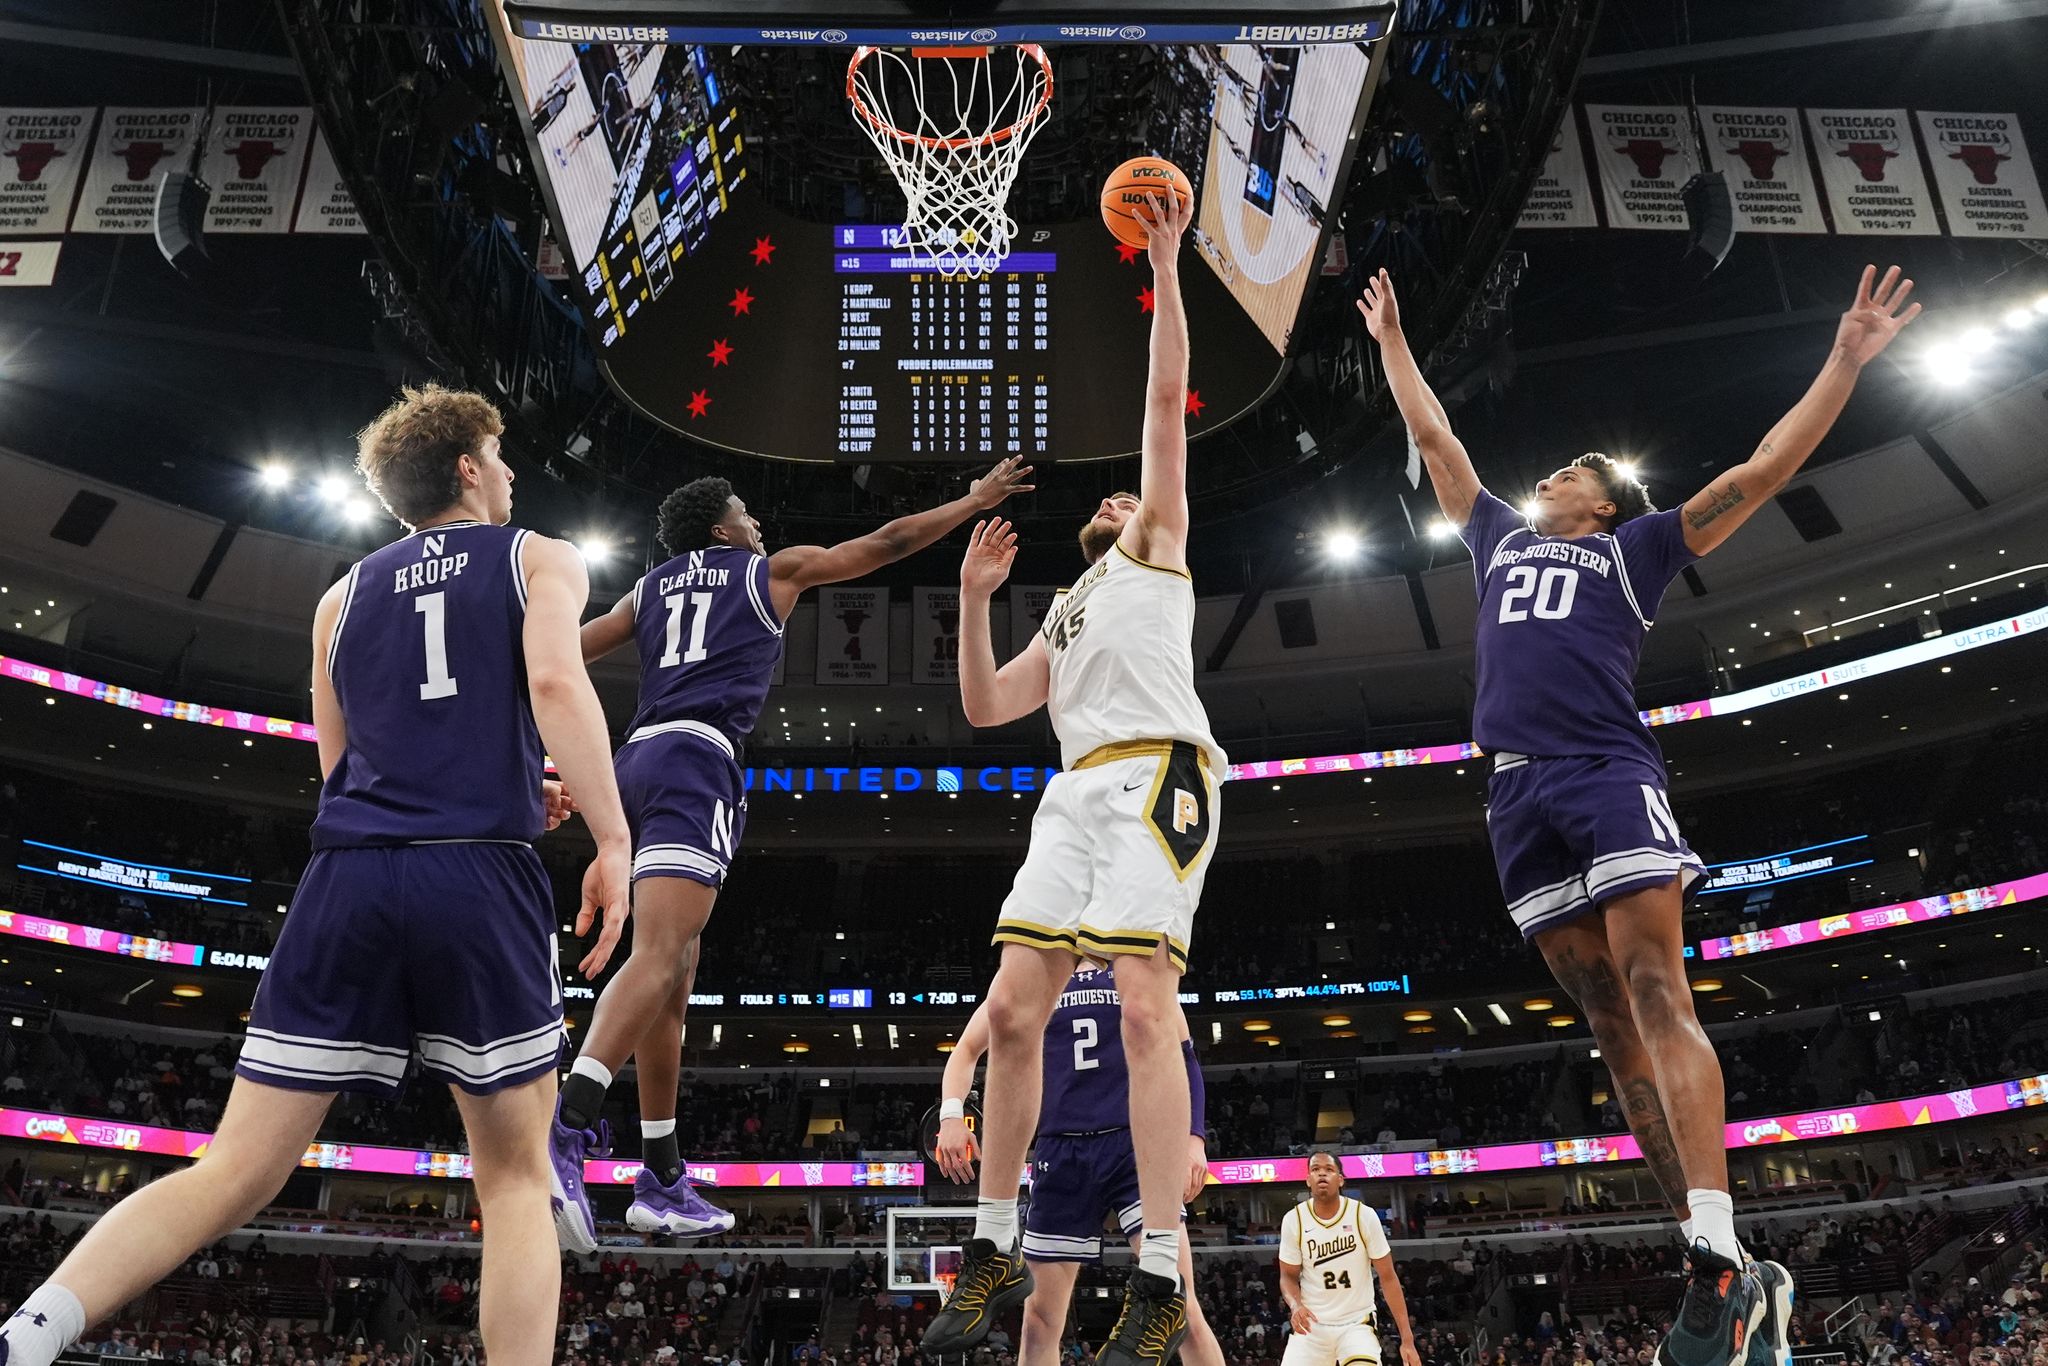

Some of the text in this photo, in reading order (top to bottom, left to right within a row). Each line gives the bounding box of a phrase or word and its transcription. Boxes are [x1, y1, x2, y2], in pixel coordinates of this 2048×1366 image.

[537, 24, 669, 42] #B1GMBBT
[762, 30, 820, 40] Allstate
[911, 31, 970, 40] Allstate
[1060, 26, 1120, 38] Allstate
[1235, 22, 1369, 41] #B1GMBBT
[8, 115, 81, 127] CHICAGO
[116, 114, 190, 126] CHICAGO
[226, 114, 299, 125] CHICAGO
[1602, 112, 1677, 125] CHICAGO
[1712, 112, 1787, 126] CHICAGO
[1820, 116, 1896, 128] CHICAGO
[1932, 118, 2008, 130] CHICAGO
[16, 128, 70, 140] BULLS
[123, 128, 180, 139] BULLS
[234, 128, 287, 138] BULLS
[1616, 126, 1669, 137] BULLS
[1728, 128, 1780, 138] BULLS
[1836, 129, 1889, 140] BULLS
[1948, 132, 2001, 143] BULLS
[1132, 168, 1176, 182] NCAA
[4, 182, 48, 192] CENTRAL
[111, 184, 156, 193] CENTRAL
[224, 183, 268, 191] CENTRAL
[1631, 180, 1675, 188] EASTERN
[1744, 180, 1787, 190] EASTERN
[1854, 185, 1900, 194] EASTERN
[1624, 190, 1681, 200] CONFERENC
[1736, 192, 1801, 202] CONFERENCE
[1968, 187, 2012, 197] EASTERN
[106, 196, 154, 205] DIVISION
[220, 194, 268, 203] DIVISION
[1848, 197, 1914, 206] CONFERENCE
[1961, 198, 2027, 209] CONFERENCE
[95, 208, 154, 216] CHAMPION
[209, 206, 273, 215] CHAMPIONS
[1738, 204, 1803, 214] CHAMPIONS
[1852, 208, 1916, 218] CHAMPIONS
[1751, 216, 1796, 225] 1995-96
[1964, 210, 2030, 220] CHAMPIONS
[99, 220, 149, 228] 1996-97
[1861, 220, 1912, 229] 1996-97
[844, 229, 854, 244] N
[0, 252, 22, 276] 2
[842, 258, 860, 268] #15
[850, 284, 873, 295] KROPP
[913, 284, 919, 295] 6
[850, 298, 891, 309] MARTINELLI
[912, 298, 921, 309] 13
[850, 312, 870, 322] WEST
[912, 312, 921, 322] 12
[841, 326, 919, 336] 11 CLAYTON 3
[838, 340, 919, 350] 20 MULLINS 4
[842, 359, 994, 370] #7 PURDUE BOILERMAKERS
[850, 386, 872, 396] SMITH
[912, 386, 921, 396] 11
[840, 400, 919, 410] 14 BENTER 3
[840, 414, 919, 424] 17 MAYER 5
[838, 428, 919, 438] 24 HARRIS 6
[839, 441, 848, 452] 45
[850, 441, 872, 452] CLUFF
[912, 441, 921, 452] 10
[422, 534, 446, 558] N
[688, 550, 705, 570] N
[394, 552, 468, 594] KROPP
[659, 568, 730, 595] CLAYTON
[1498, 566, 1579, 624] 20
[659, 592, 714, 668] 11
[1055, 606, 1086, 652] 45
[1954, 626, 2008, 648] ULTRA
[414, 590, 458, 700] 1
[1770, 663, 1868, 698] ULTRA SUITE
[1173, 788, 1198, 834] P
[1640, 784, 1680, 848] N
[712, 798, 732, 860] N
[126, 866, 147, 880] TIAA
[1713, 870, 1772, 888] BASKETBALL
[1772, 856, 1834, 878] TOURNAMENT
[1750, 862, 1770, 874] TIAA
[58, 862, 212, 896] MEN'S BASKETBALL TOURNAMENT
[210, 950, 244, 968] 6:04
[564, 987, 594, 998] 3PT%
[1176, 980, 1400, 1004] NUS FG% 59.1% 3PT% 44.4% FT% 100%
[688, 994, 824, 1005] BONUS FOULS 5 TOL 3
[830, 990, 977, 1007] #15 N 13 7:00 1ST
[1072, 1018, 1100, 1071] 2
[26, 1118, 68, 1136] Crush
[100, 1126, 141, 1147] B1G
[1743, 1120, 1782, 1144] Crush
[1816, 1112, 1857, 1135] B1G
[1238, 1163, 1275, 1180] B1G
[1306, 1234, 1357, 1260] Purdue
[1322, 1270, 1352, 1290] 24
